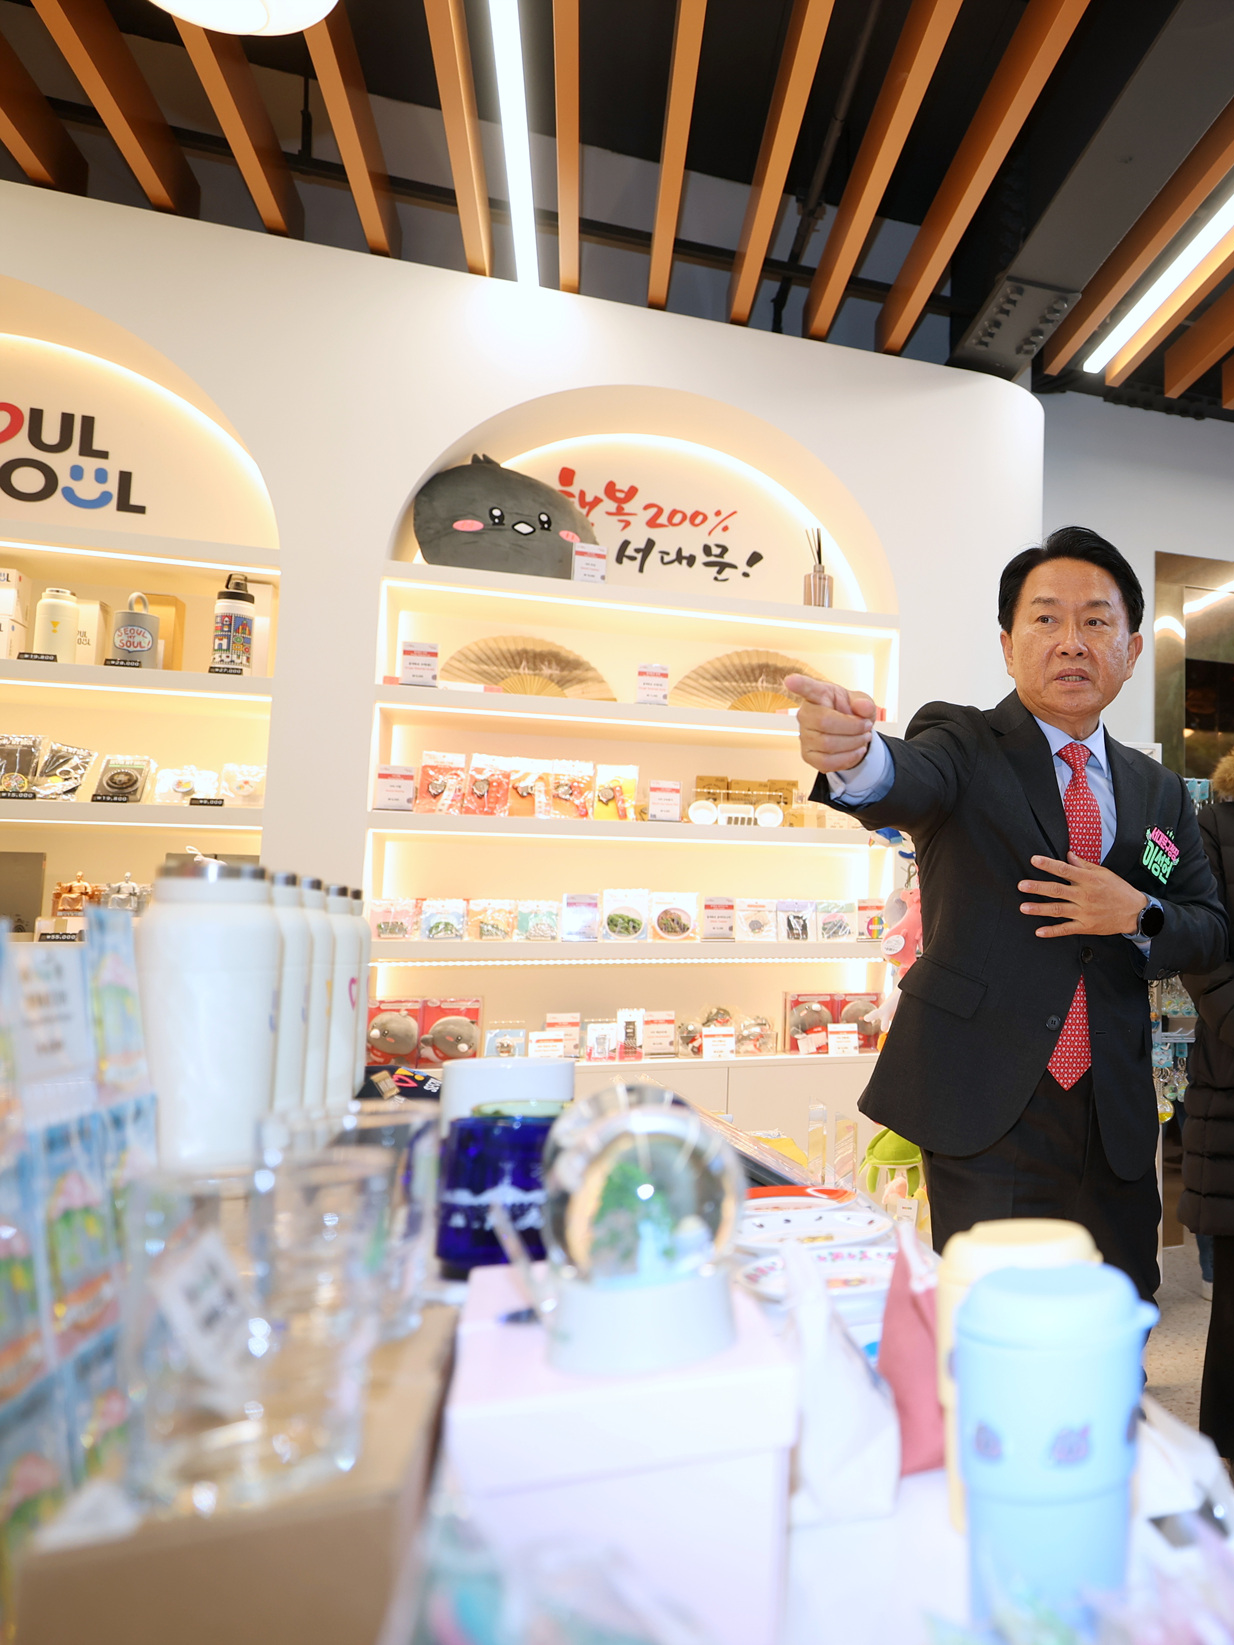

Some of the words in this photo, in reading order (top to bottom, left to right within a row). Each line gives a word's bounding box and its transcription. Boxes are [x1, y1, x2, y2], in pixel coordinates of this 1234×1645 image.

[642, 502, 738, 537] 200%
[615, 537, 764, 582] 서대문!
[117, 627, 148, 639] SEOUL
